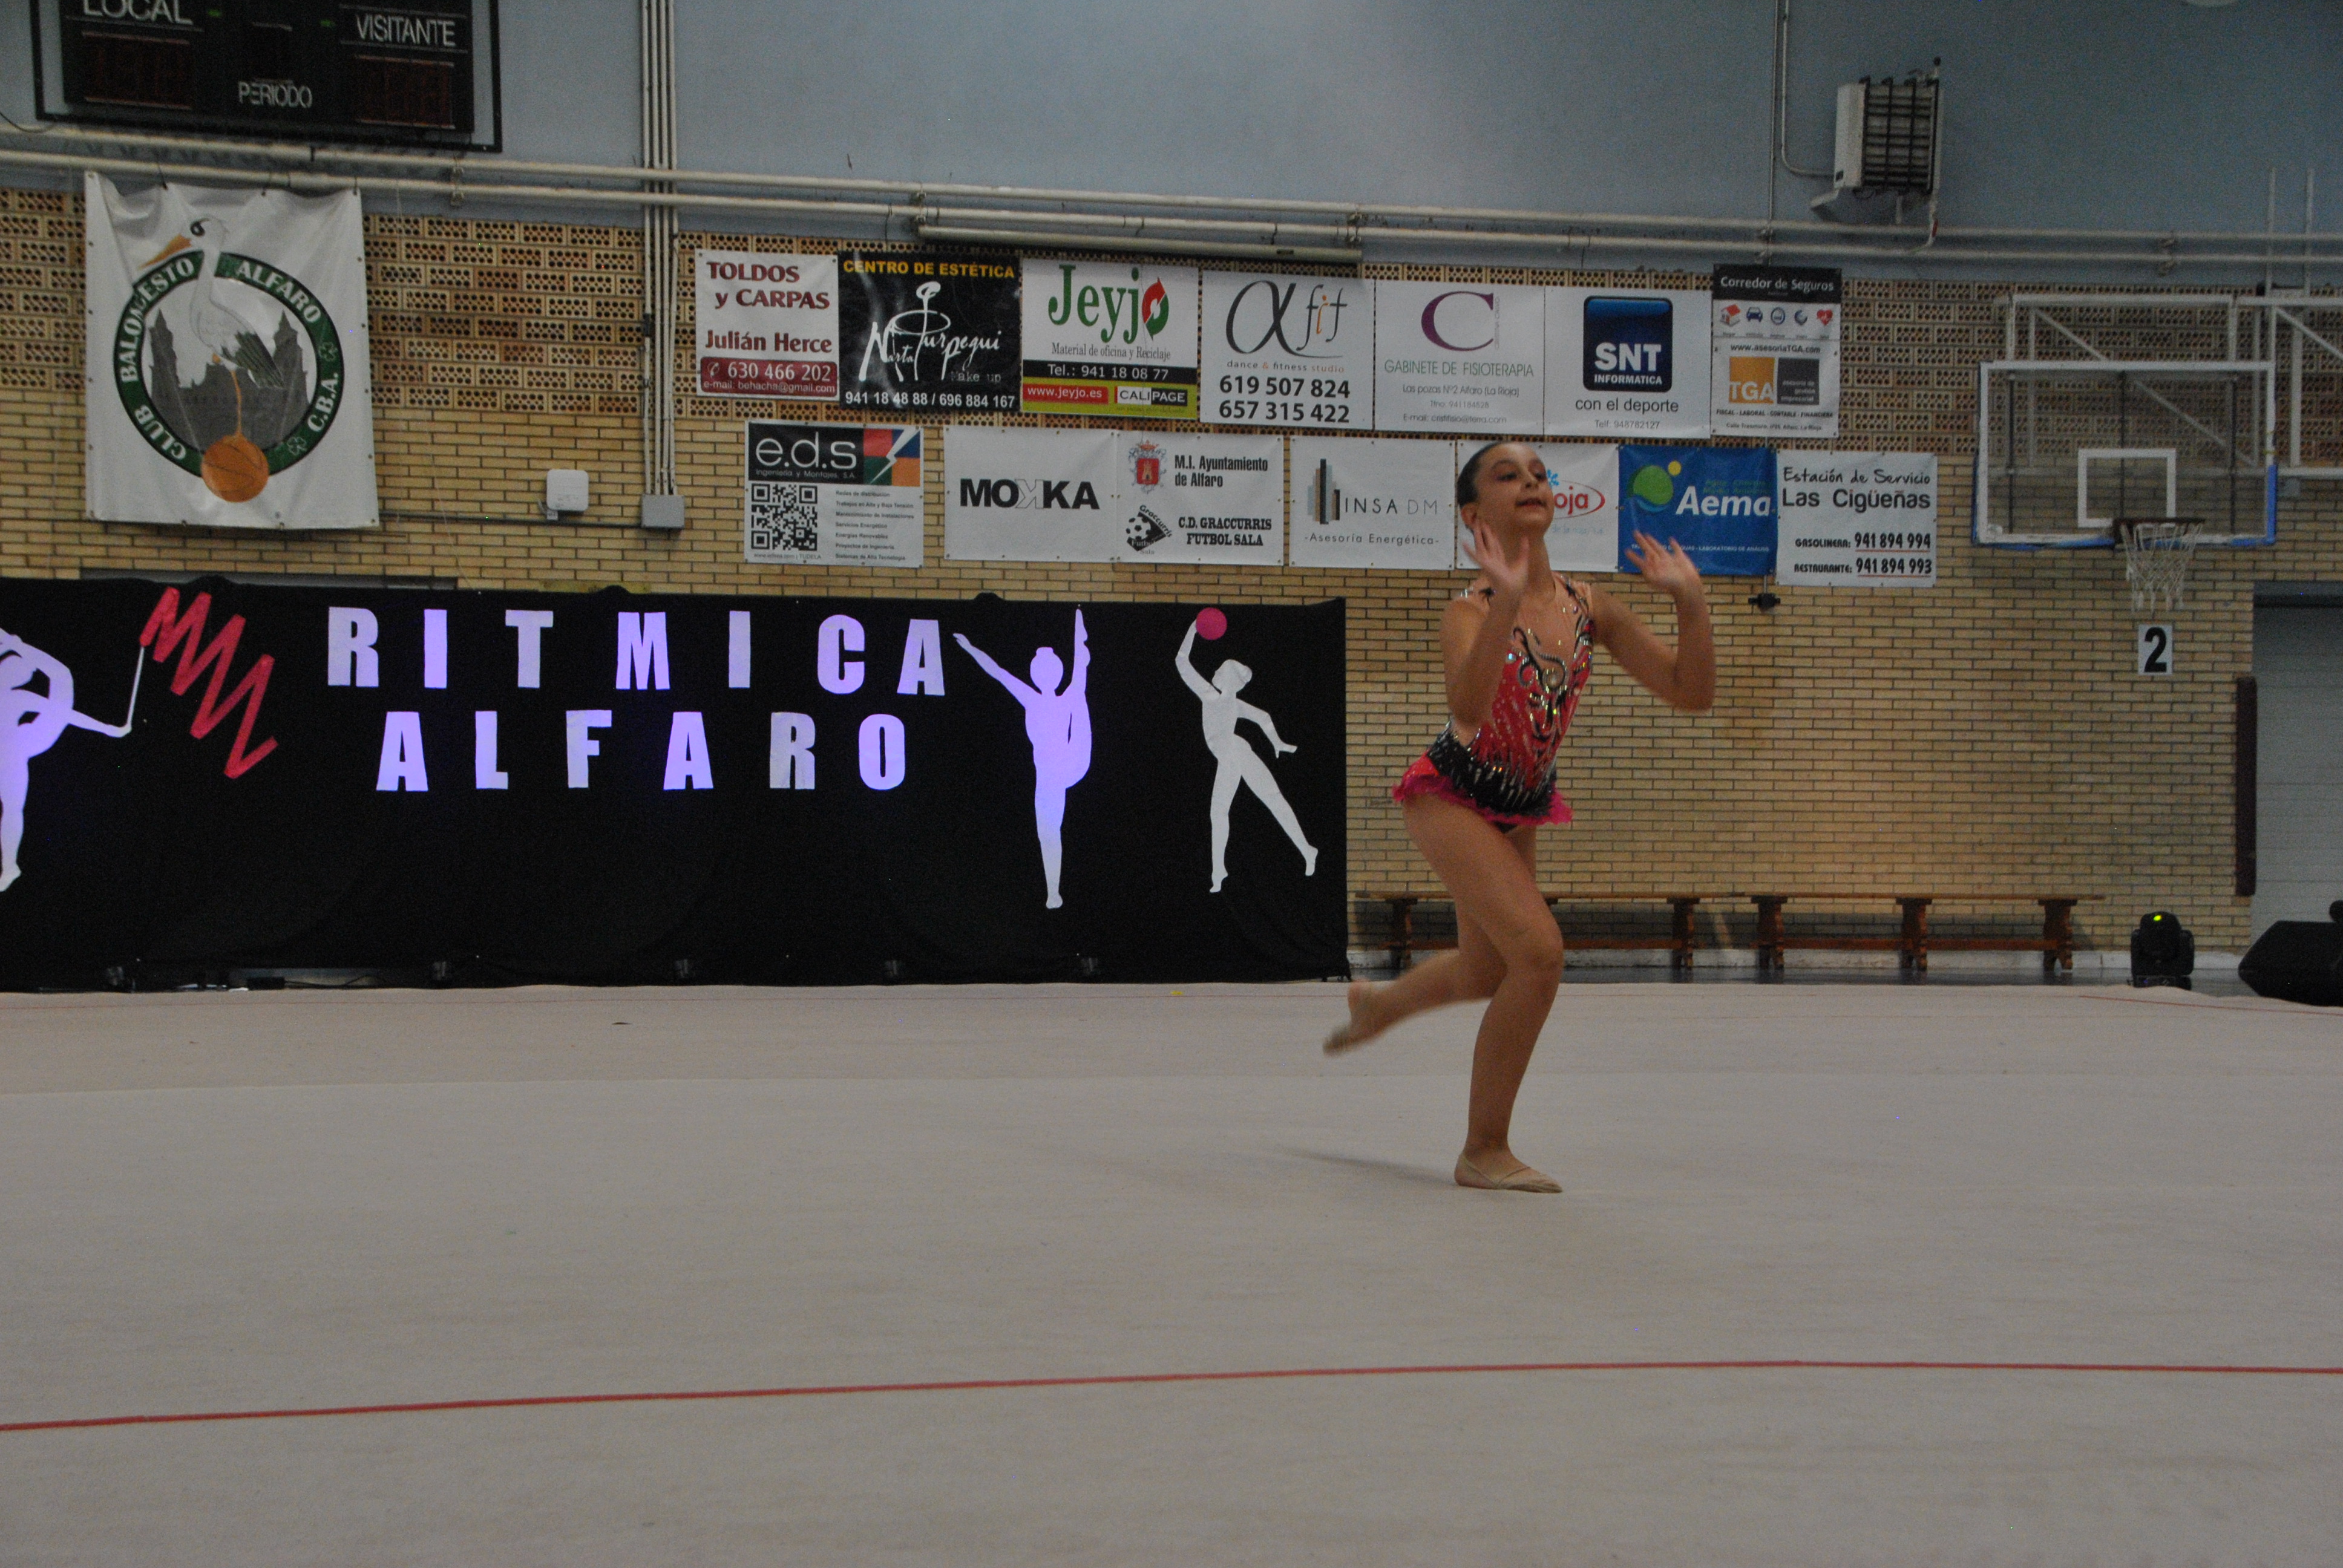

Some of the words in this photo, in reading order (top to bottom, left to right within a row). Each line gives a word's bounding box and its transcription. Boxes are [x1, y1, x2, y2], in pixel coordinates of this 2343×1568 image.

[82, 0, 194, 25] LOCAL
[356, 14, 456, 47] VISITANTE
[238, 81, 313, 109] PERIODO
[706, 261, 800, 283] TOLDOS
[844, 260, 909, 275] CENTRO
[914, 262, 934, 275] DE
[939, 262, 1015, 278] ESTÉTICA
[1720, 276, 1772, 289] Corredor
[1774, 278, 1788, 289] de
[1791, 279, 1834, 294] Seguros
[715, 292, 729, 309] y
[736, 289, 831, 309] CARPAS
[1421, 290, 1493, 351] C
[705, 330, 766, 351] Julián
[774, 332, 832, 353] Herce
[134, 405, 186, 460] CLUB
[235, 261, 321, 323] ALFARO
[1052, 342, 1086, 356] Material
[1089, 345, 1098, 356] de
[1100, 344, 1127, 357] oficina
[1129, 348, 1133, 359] y
[1136, 346, 1171, 362] Reciclaje
[1594, 342, 1662, 372] SNT
[727, 362, 759, 379] 630
[765, 364, 795, 380] 466
[801, 365, 831, 382] 202
[1047, 364, 1075, 376] Tel.:
[1081, 365, 1105, 377] 941
[1112, 367, 1127, 378] 18
[1132, 367, 1148, 379] 08
[1153, 368, 1168, 380] 77
[1227, 360, 1258, 368] dance
[1273, 361, 1307, 371] fitness
[1311, 364, 1345, 373] studio
[1384, 359, 1438, 375] GABINETE
[1442, 361, 1457, 375] DE
[1463, 362, 1534, 377] FISIOTERAPIA
[1219, 375, 1259, 394] 619
[1265, 376, 1305, 396] 507
[1310, 379, 1350, 399] 824
[1403, 384, 1415, 393] Las
[1417, 385, 1441, 395] pozas
[1460, 385, 1483, 394] Alfaro
[1594, 374, 1662, 385] INFORMATICA
[845, 391, 868, 405] 941
[874, 391, 888, 405] 18
[893, 392, 908, 405] 48
[913, 393, 928, 405] 88
[940, 393, 962, 407] 696
[966, 394, 989, 407] 884
[993, 395, 1015, 408] 167
[1027, 387, 1103, 399] www.jeyjo.es
[1119, 390, 1185, 402] CALIPAGE
[1729, 381, 1774, 402] TGA
[307, 372, 339, 433] C.B.A.
[1219, 400, 1259, 419] 657
[1265, 402, 1305, 421] 315
[1310, 404, 1349, 423] 422
[1575, 399, 1601, 411] con
[1606, 397, 1619, 411] el
[1624, 398, 1679, 415] deporte
[756, 431, 857, 469] e.d.s
[1175, 454, 1195, 469] M.I.
[1199, 456, 1268, 472] Ayuntamiento
[1175, 472, 1187, 486] de
[1190, 472, 1223, 487] Alfaro
[1783, 466, 1843, 483] Estación
[1850, 469, 1868, 483] de
[1873, 469, 1930, 485] Servicio
[1345, 497, 1398, 514] INSA
[1407, 499, 1437, 515] DM
[1676, 485, 1771, 517] Aema
[1782, 488, 1820, 508] Las
[1833, 488, 1931, 514] Cigüeñas
[1179, 517, 1198, 529] C.D.
[1199, 517, 1272, 530] GRACCURRIS
[1187, 533, 1232, 546] FUTBOL
[1234, 534, 1263, 546] SALA
[1854, 532, 1876, 548] 941
[1880, 533, 1903, 549] 894
[1907, 533, 1931, 549] 994
[1856, 557, 1877, 573] 941
[1881, 558, 1904, 573] 894
[1909, 558, 1932, 574] 993
[327, 606, 946, 696] RITMICA
[2143, 626, 2168, 673] 2
[376, 710, 906, 792] ALFARO
